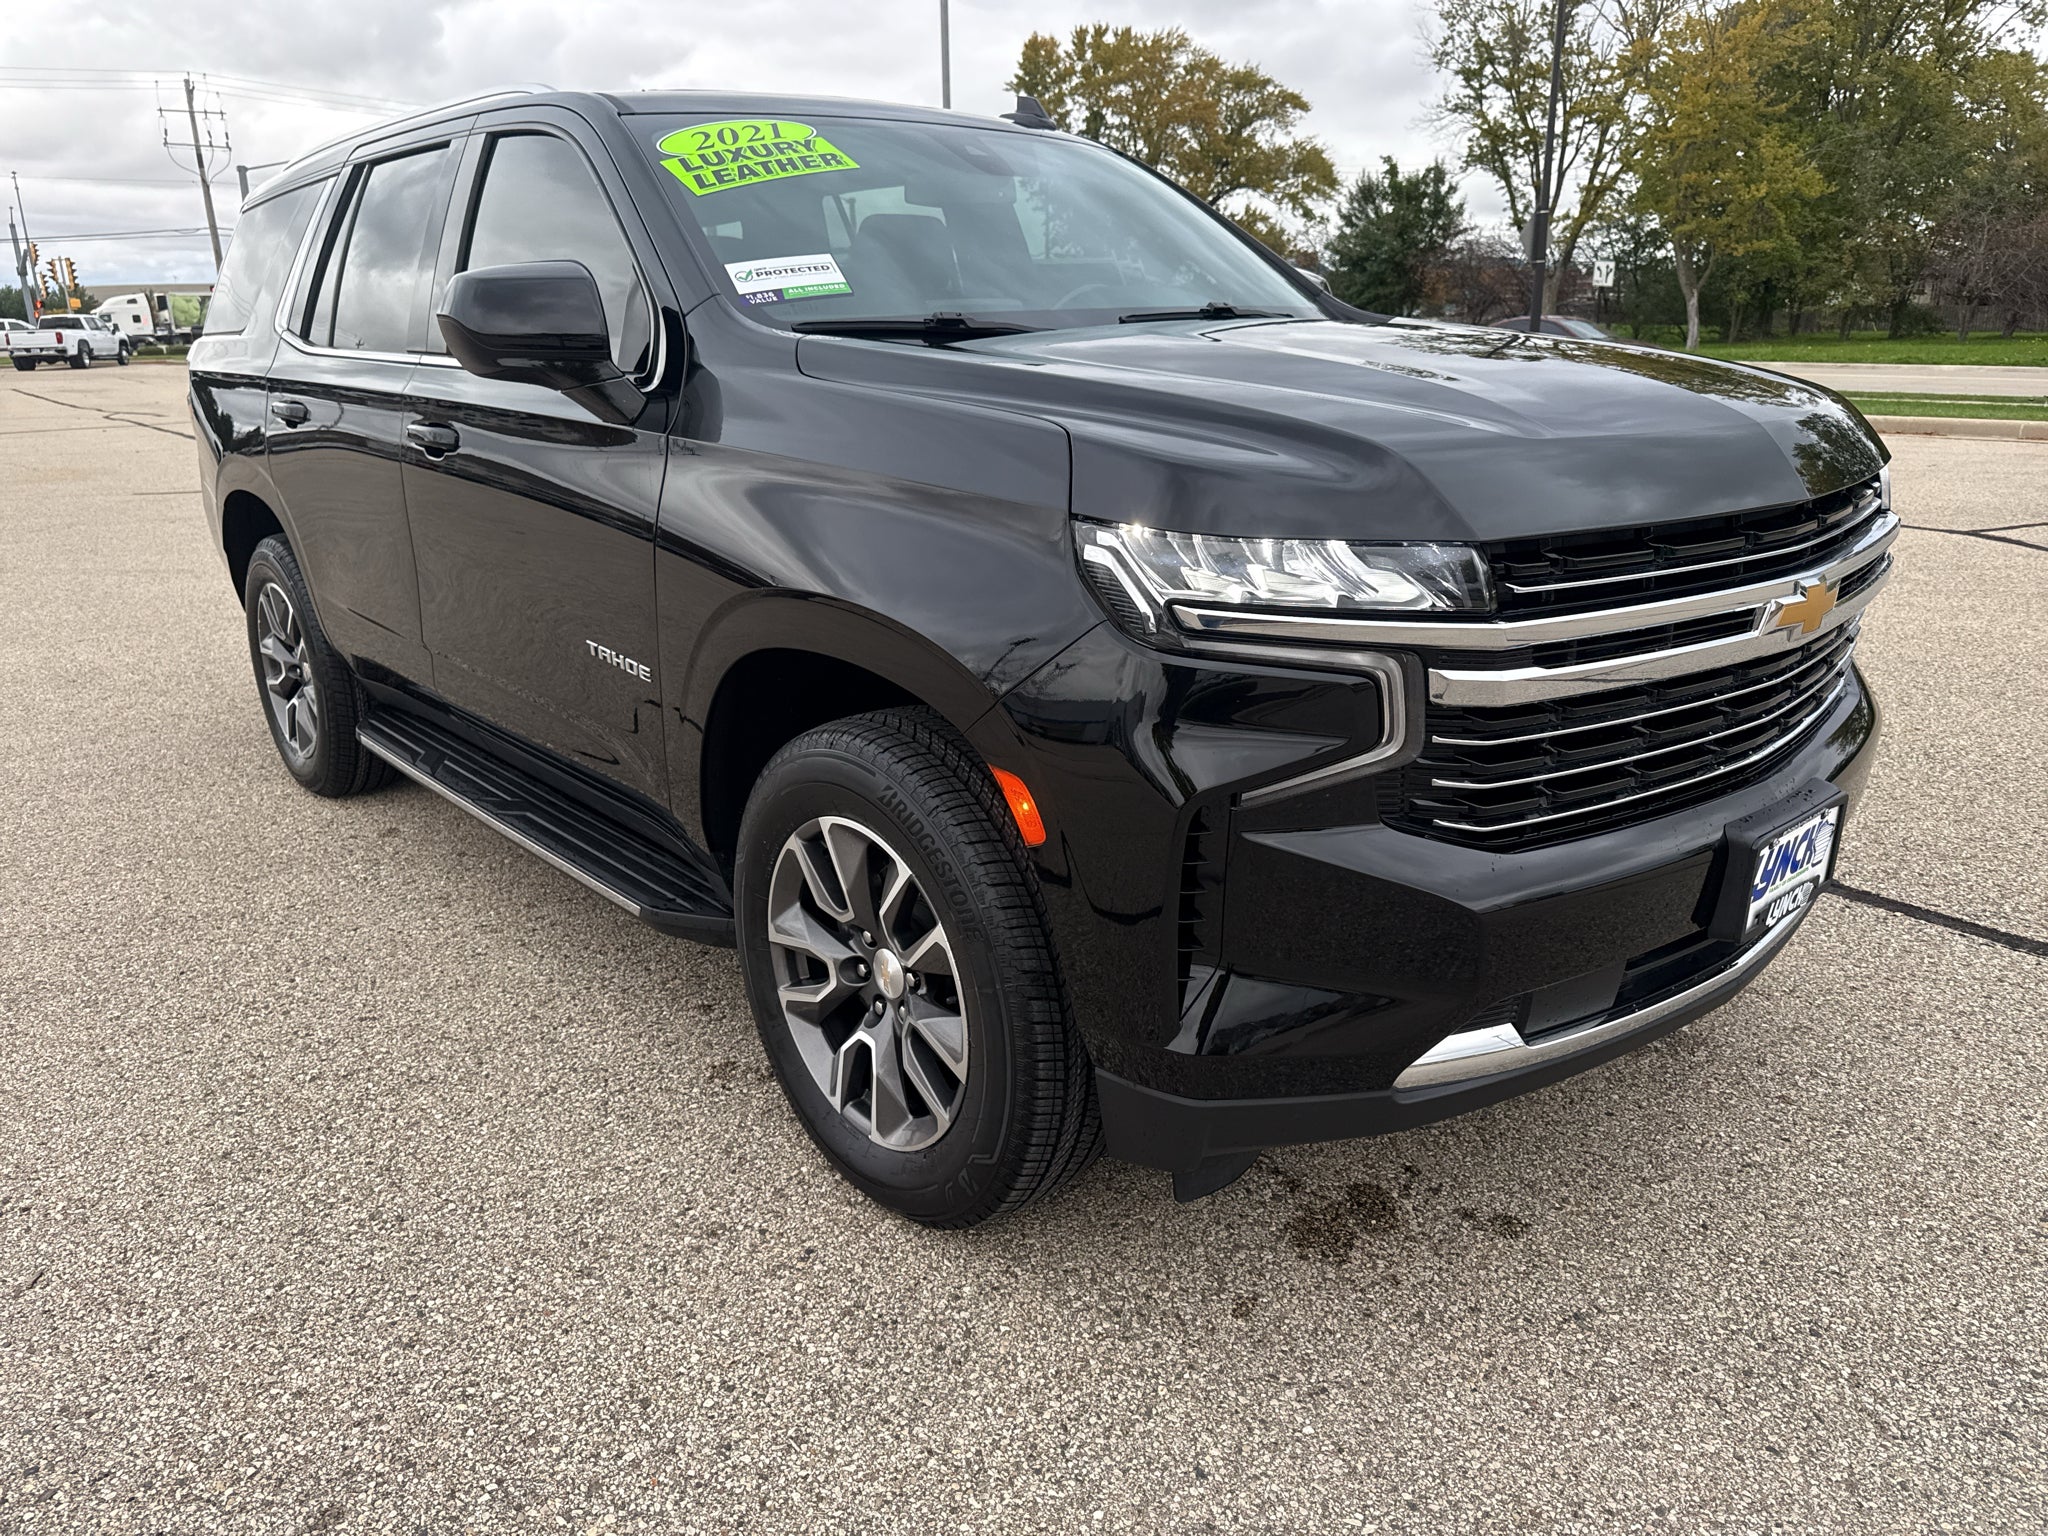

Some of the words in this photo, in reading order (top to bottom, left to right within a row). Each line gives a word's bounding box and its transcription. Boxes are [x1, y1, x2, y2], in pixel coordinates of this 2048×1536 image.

[691, 122, 787, 151] 2021
[678, 139, 817, 173] LUXURY
[692, 153, 844, 190] LEATHER
[756, 265, 830, 277] PROTECTED
[749, 296, 779, 304] VALUE
[804, 284, 845, 292] INCLUDED
[586, 640, 652, 683] TAHOE
[877, 784, 983, 943] BRIDGESTONE
